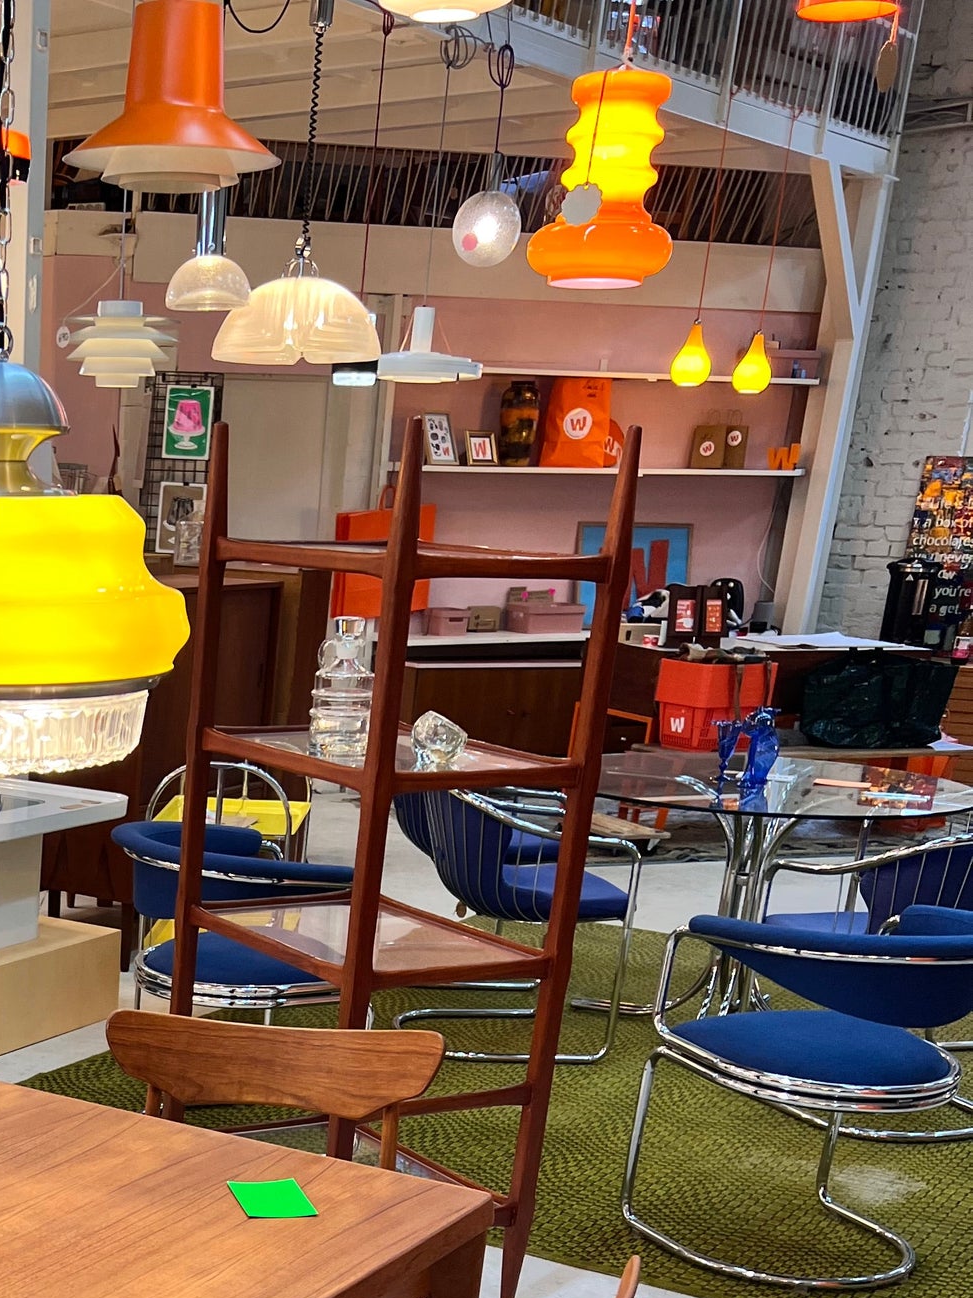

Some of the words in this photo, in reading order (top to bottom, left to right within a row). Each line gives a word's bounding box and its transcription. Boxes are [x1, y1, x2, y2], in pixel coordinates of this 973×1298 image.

[570, 416, 587, 431] W
[730, 433, 739, 442] W
[473, 439, 487, 458] W
[702, 443, 712, 453] W
[768, 443, 801, 470] W
[933, 585, 972, 599] you're
[670, 717, 685, 733] W
